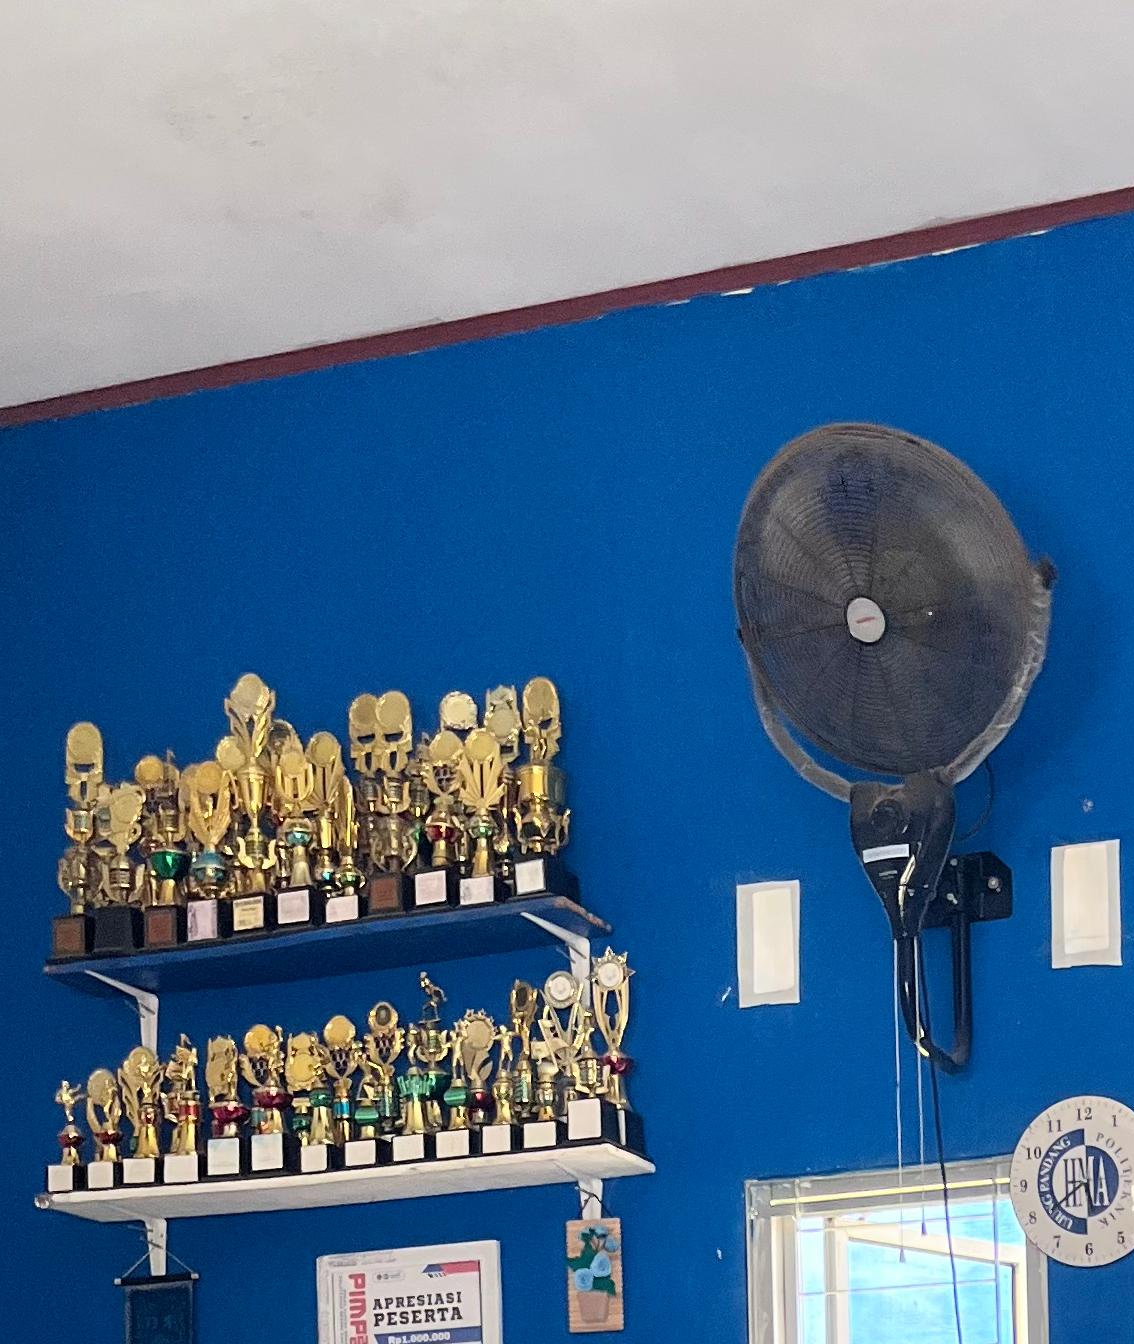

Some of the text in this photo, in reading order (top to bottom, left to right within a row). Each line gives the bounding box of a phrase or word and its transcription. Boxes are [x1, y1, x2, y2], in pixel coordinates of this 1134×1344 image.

[1075, 1106, 1093, 1121] 12
[1112, 1114, 1118, 1127] 1
[1047, 1119, 1062, 1132] 11
[1025, 1146, 1042, 1160] 10
[1039, 1135, 1071, 1191] PANDANG
[1019, 1179, 1028, 1193] 9
[1063, 1155, 1111, 1207] HMA
[1028, 1211, 1037, 1225] 8
[1053, 1235, 1062, 1249] 7
[1117, 1231, 1126, 1245] 5
[1085, 1242, 1094, 1256] 6
[372, 1291, 463, 1311] APRESIASI
[373, 1306, 463, 1328] PESERTA
